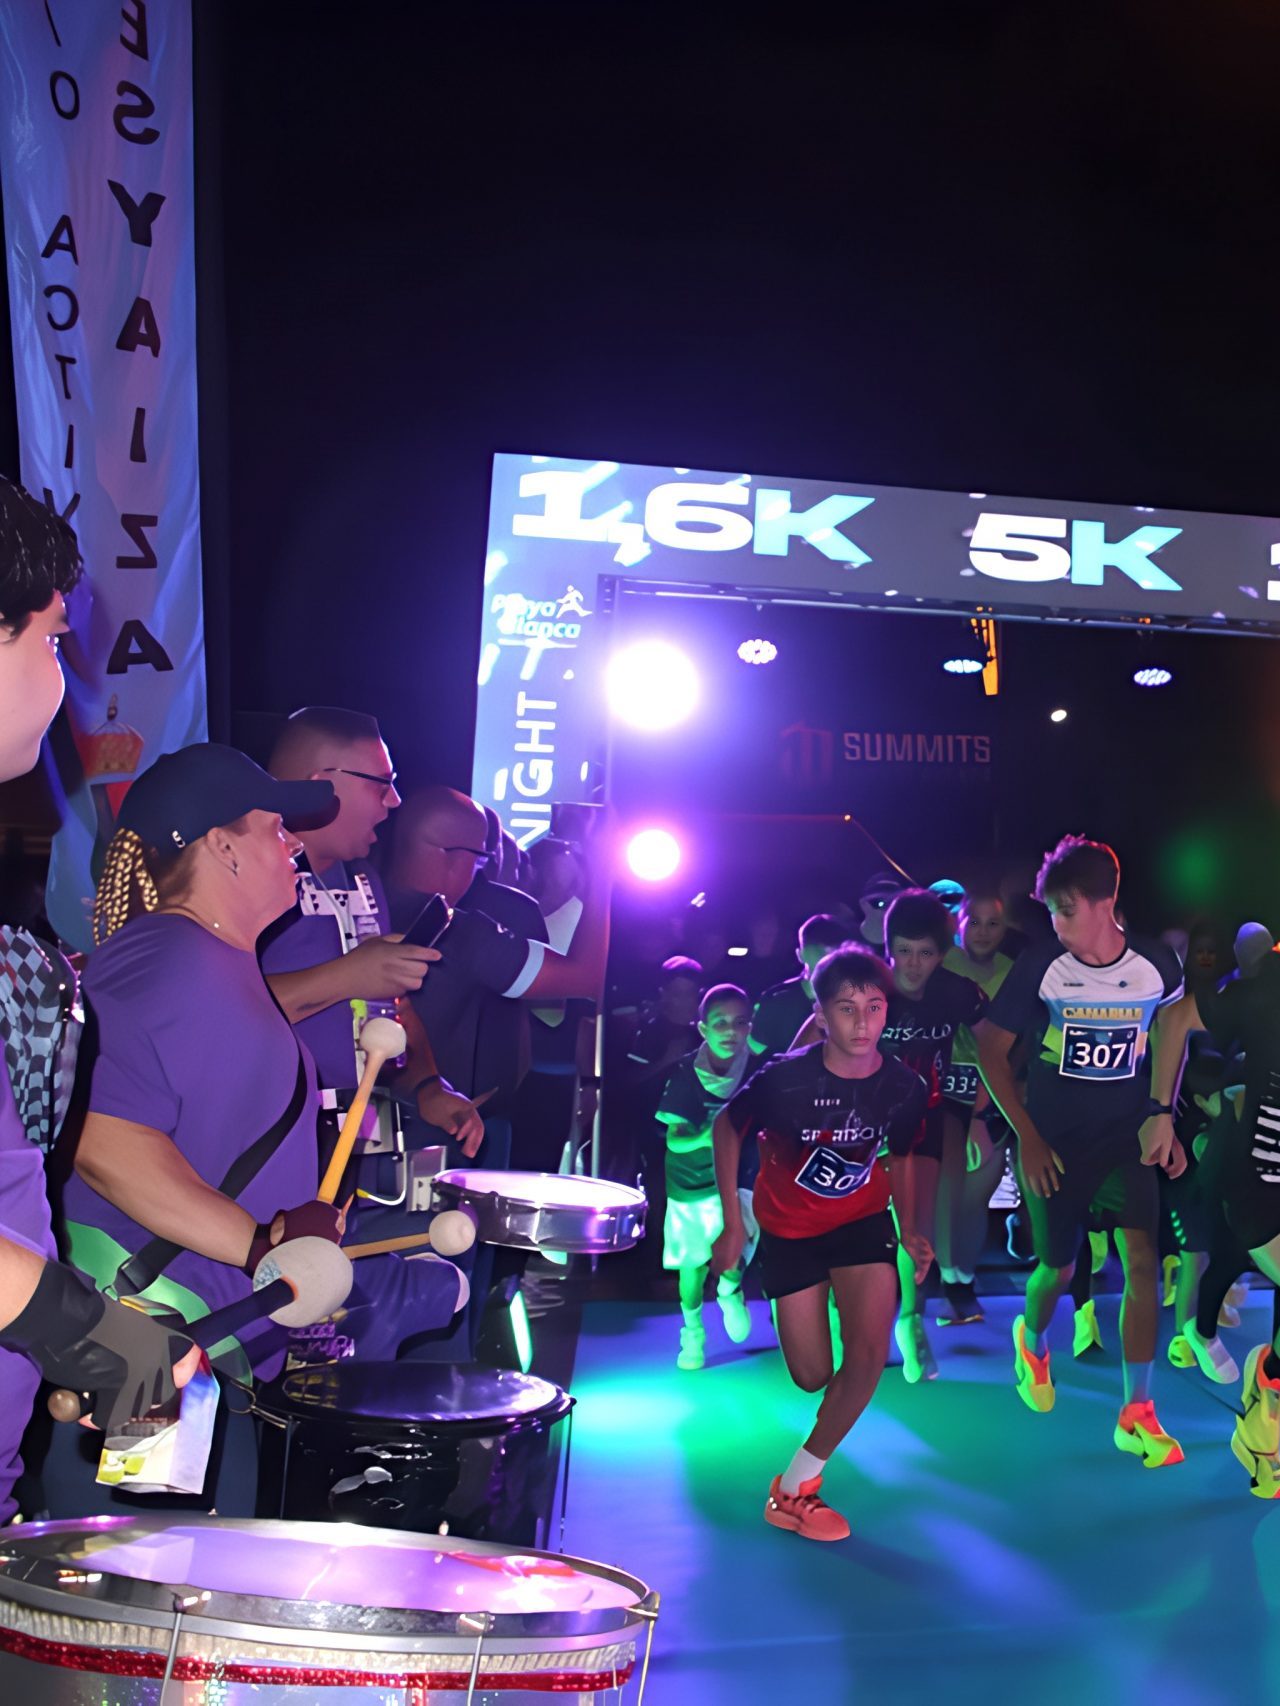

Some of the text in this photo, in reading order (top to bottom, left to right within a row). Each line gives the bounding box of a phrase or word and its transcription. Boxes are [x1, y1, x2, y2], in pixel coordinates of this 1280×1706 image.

[513, 470, 875, 566] 1,6K
[969, 513, 1183, 591] 5K
[510, 691, 557, 852] NIGHT
[843, 732, 991, 763] SUMMITS
[1073, 1042, 1127, 1069] 307
